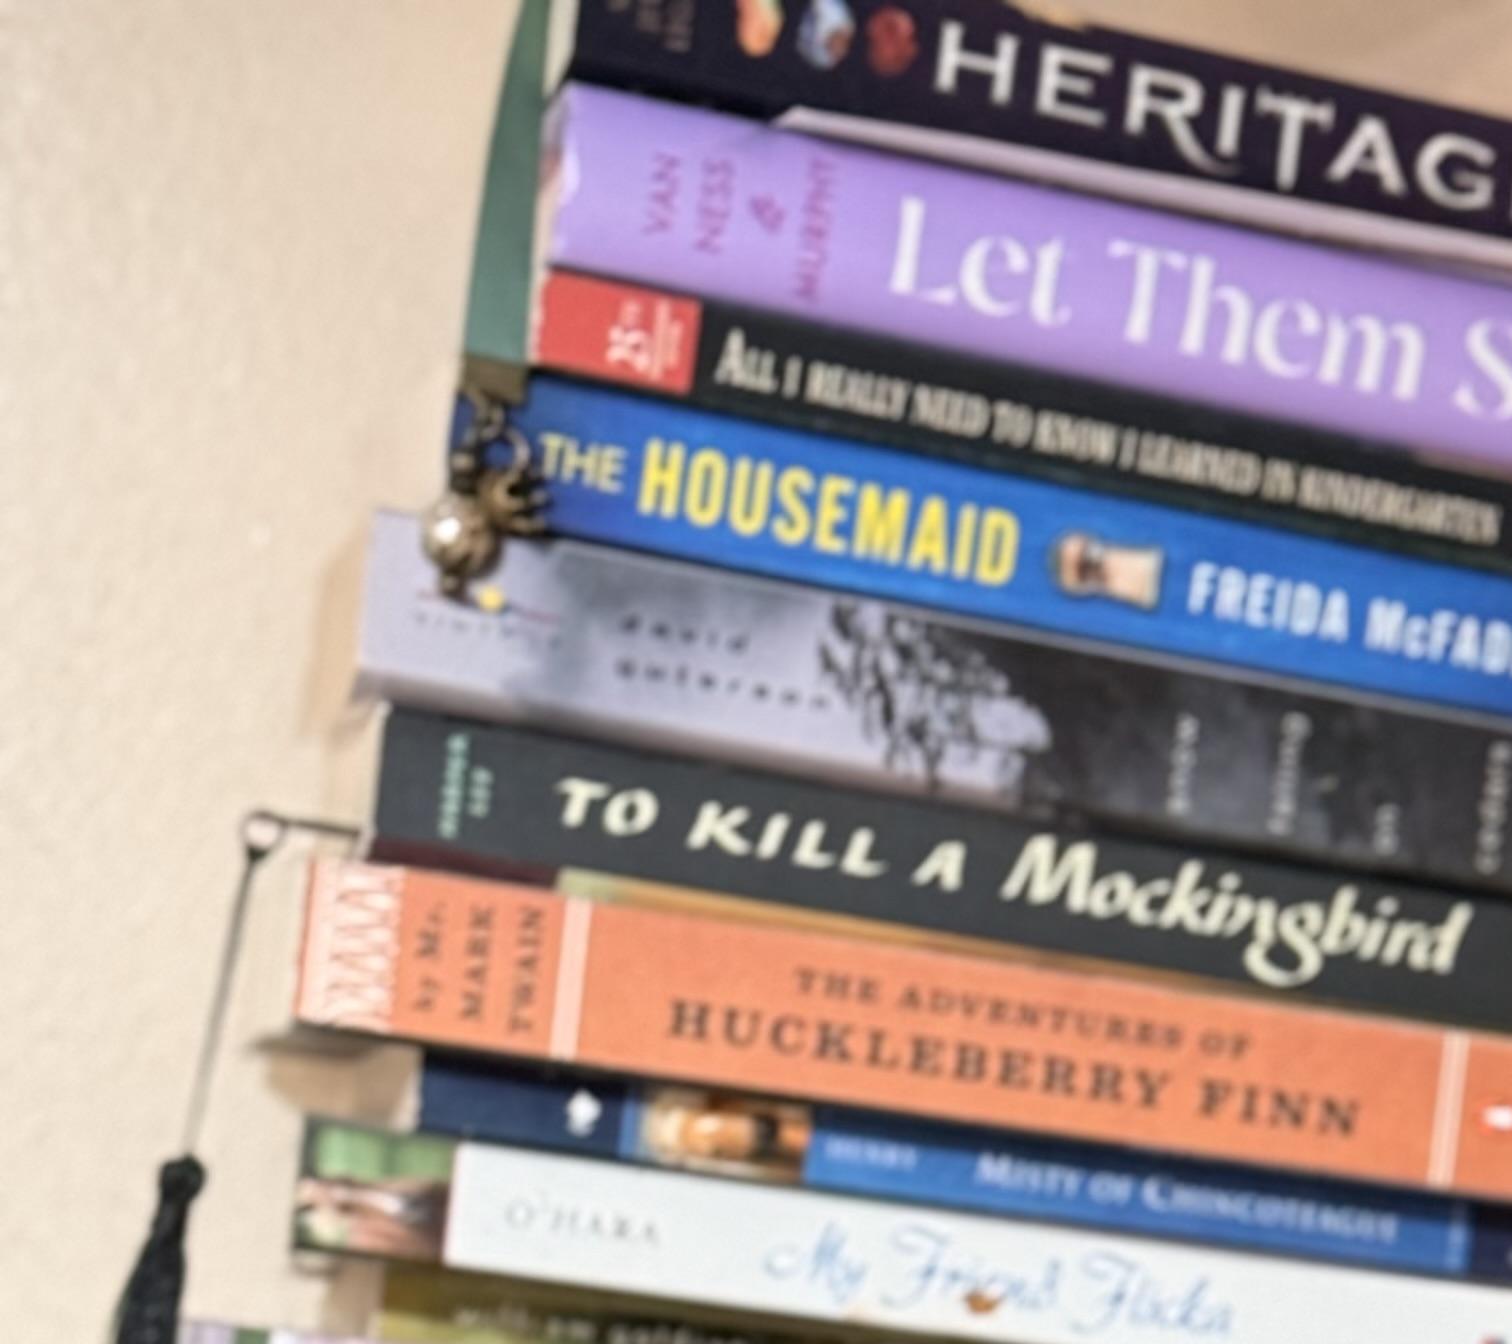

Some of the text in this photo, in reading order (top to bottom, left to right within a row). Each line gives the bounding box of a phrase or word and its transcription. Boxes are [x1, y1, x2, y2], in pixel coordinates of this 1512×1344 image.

[888, 196, 1072, 328] Let
[1106, 236, 1426, 402] Them
[909, 383, 990, 439] NEED
[992, 399, 1034, 448] TO
[1033, 409, 1118, 467] KNOW
[541, 431, 1020, 587] THE HOUSEMAID
[1187, 560, 1350, 643] FREIDA
[556, 776, 658, 838] TO
[688, 801, 888, 878] KILL
[911, 840, 968, 893] A
[1000, 832, 1473, 989] Mockingbird
[667, 998, 1360, 1138] HUCKLEBERRY FINN
[795, 966, 1252, 1061] THE ADVENTURES OF
